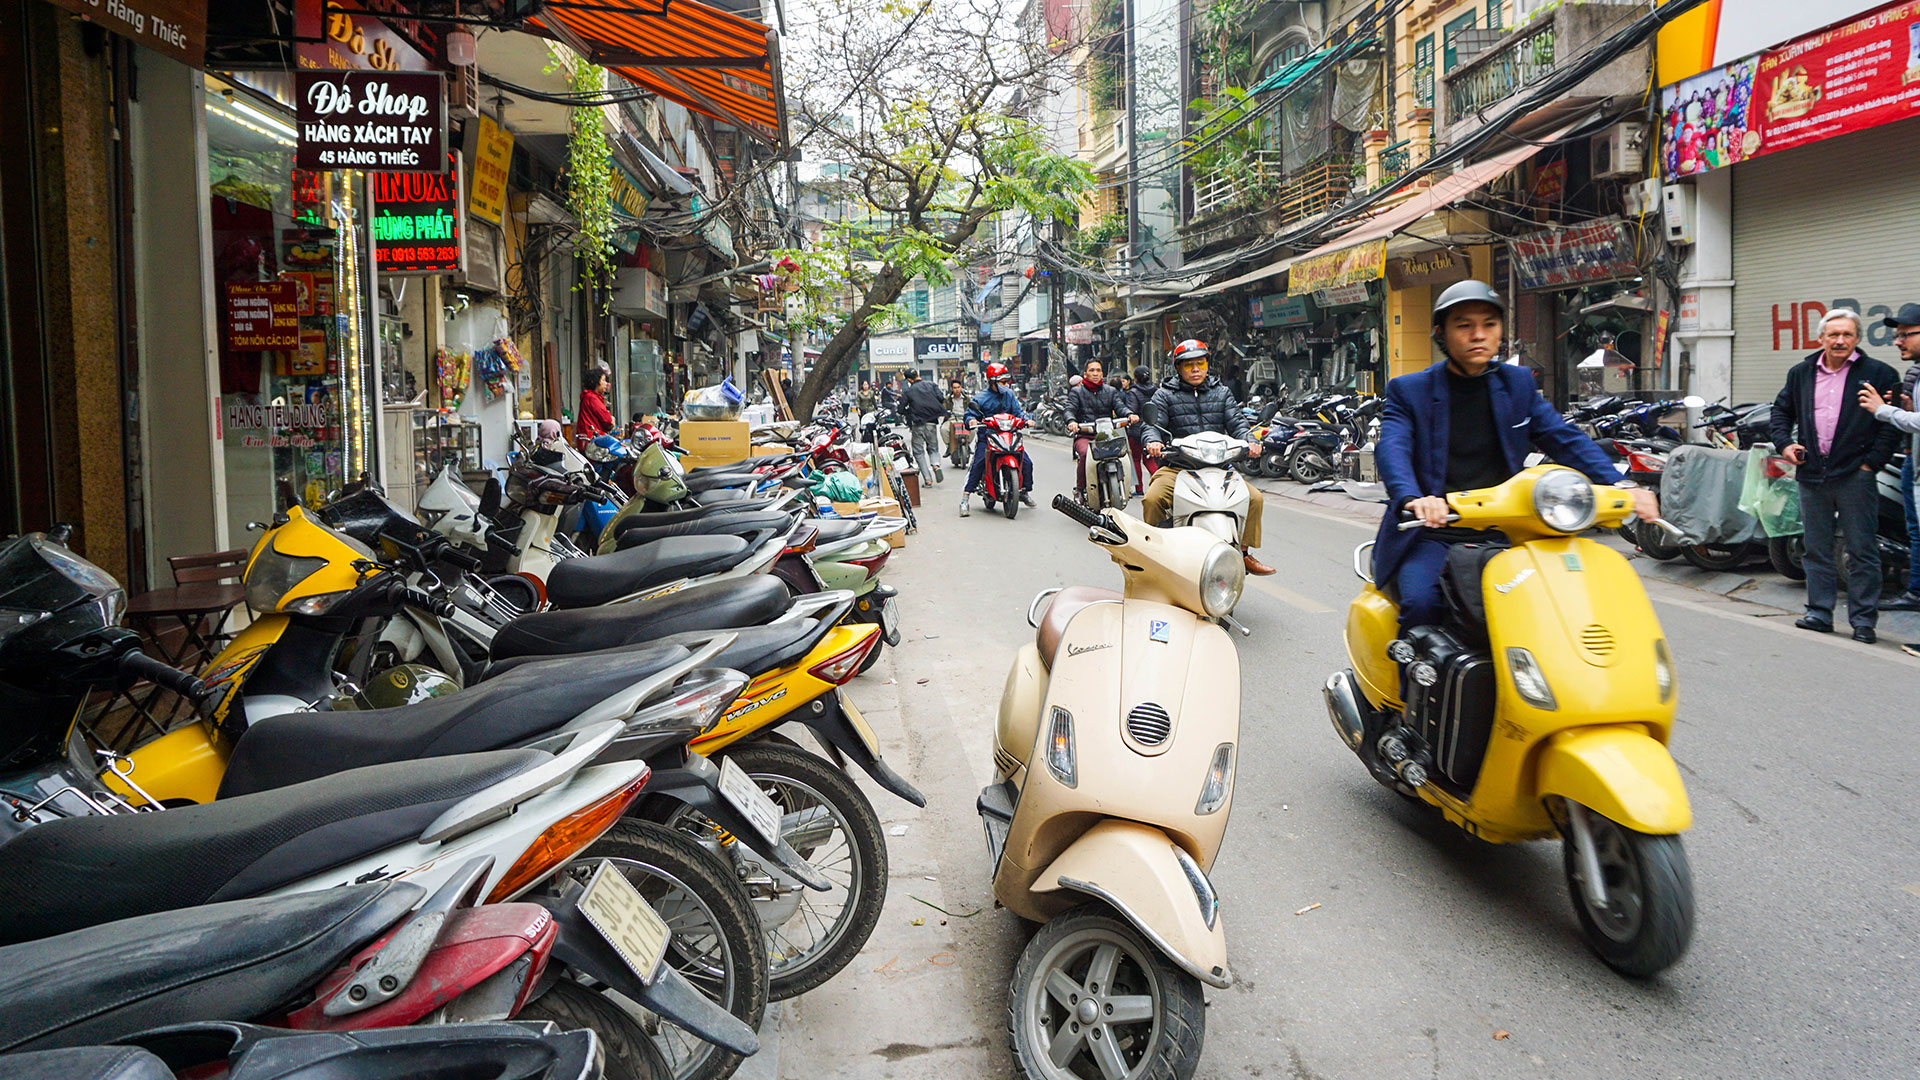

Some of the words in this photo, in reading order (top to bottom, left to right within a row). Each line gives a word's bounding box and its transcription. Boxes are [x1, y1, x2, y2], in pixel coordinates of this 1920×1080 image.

[151, 15, 187, 49] Thiếc
[1761, 55, 1778, 73] TÂN
[1779, 45, 1804, 64] XUÂN
[307, 80, 353, 114] Đô
[358, 81, 429, 123] Shop
[305, 119, 350, 143] HÀNG
[354, 120, 398, 144] XÁCH
[401, 126, 433, 145] TAY
[319, 150, 334, 164] 45
[337, 147, 377, 165] HÀNG
[379, 147, 419, 166] THIẾC
[415, 208, 454, 240] PHÁT
[392, 247, 417, 262] 0913
[418, 247, 435, 261] 563
[436, 246, 455, 261] 263
[1402, 256, 1429, 276] Hồng
[1431, 252, 1453, 270] Anh
[229, 398, 263, 429] HÀNG
[264, 399, 292, 429] TIÊU
[292, 398, 327, 428] DÙNG
[622, 905, 664, 968] 9778
